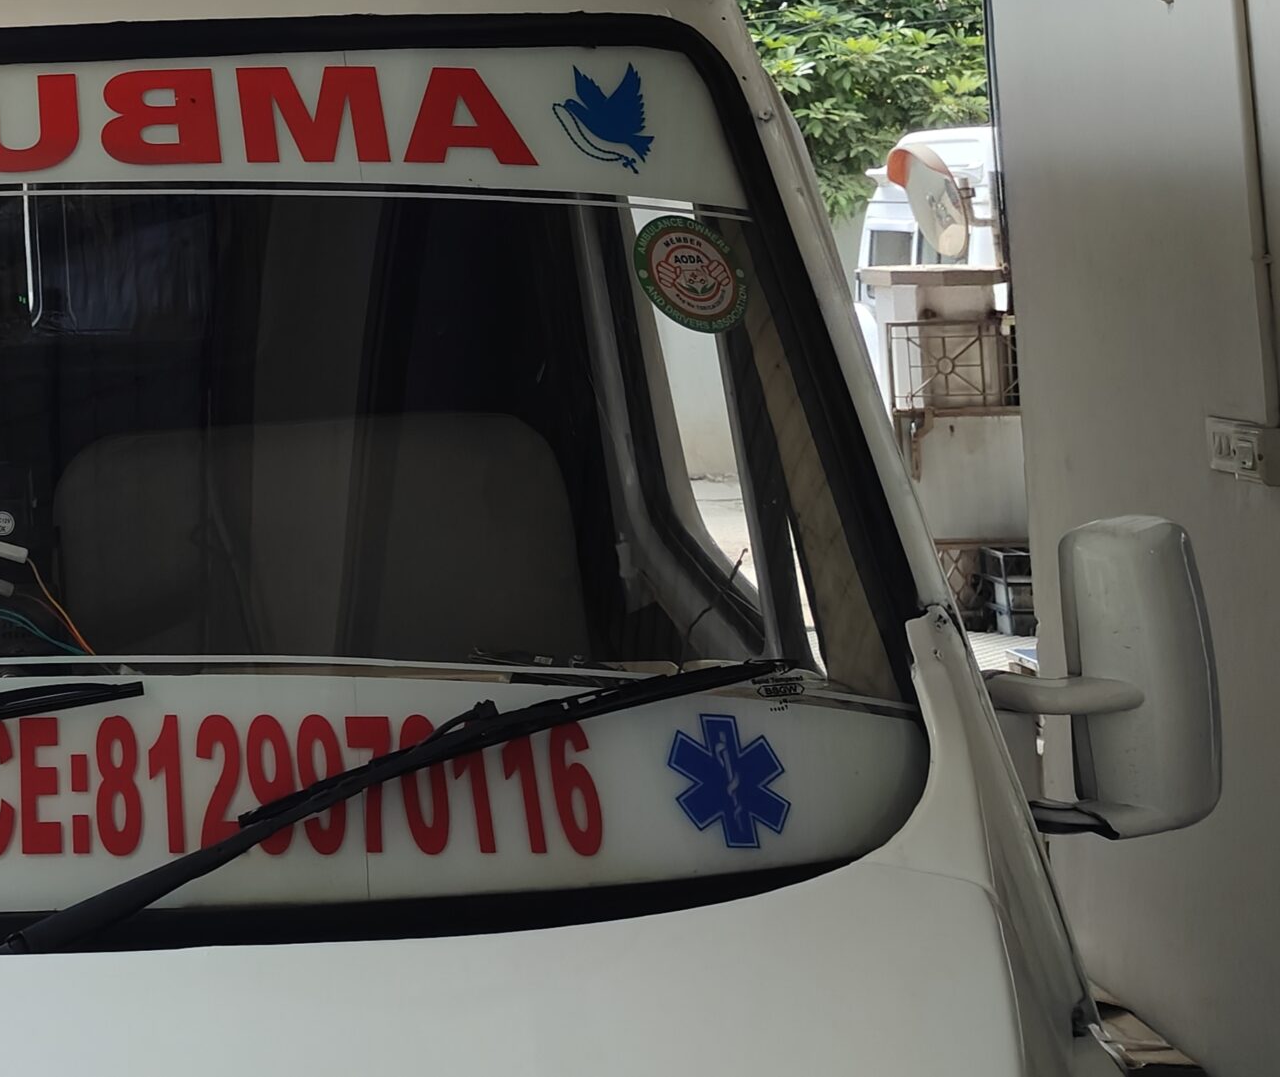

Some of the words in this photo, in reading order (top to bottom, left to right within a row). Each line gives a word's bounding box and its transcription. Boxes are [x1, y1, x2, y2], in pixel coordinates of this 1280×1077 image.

[638, 218, 685, 254] AMBULANCE
[687, 219, 731, 254] OWNERS
[663, 236, 703, 247] MEMBER
[674, 255, 704, 265] AODA
[646, 284, 665, 306] AND
[665, 305, 710, 330] DRIVERS
[711, 285, 747, 329] ASSOCIATION
